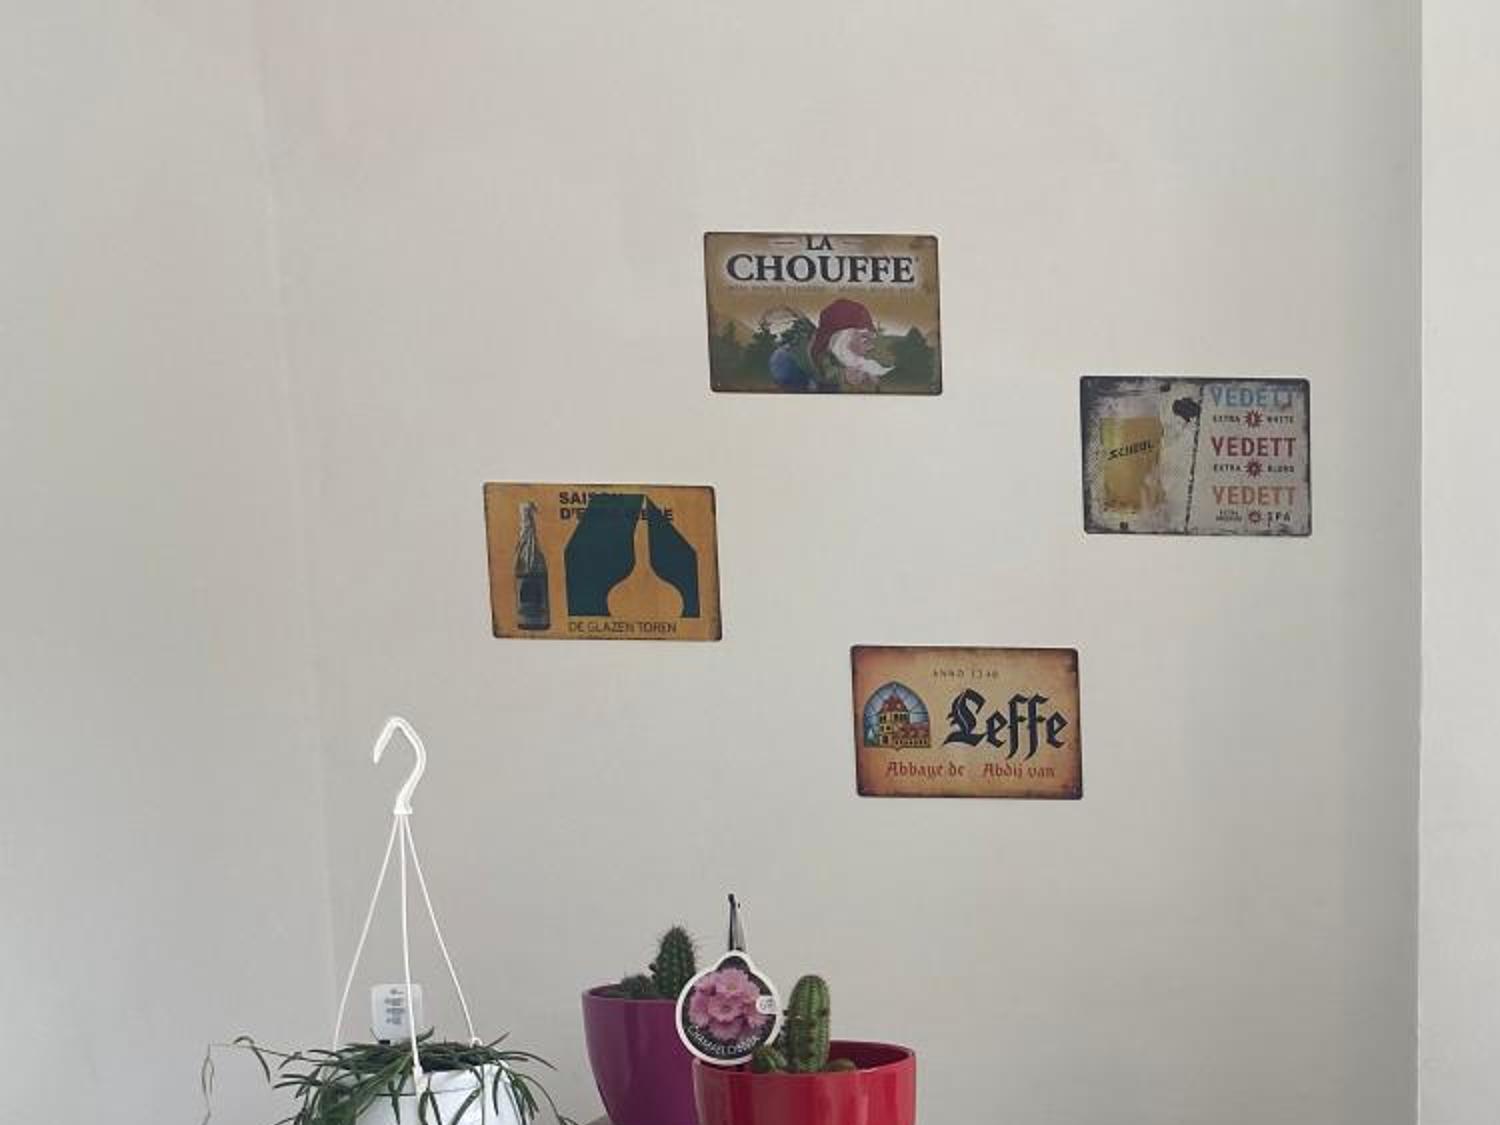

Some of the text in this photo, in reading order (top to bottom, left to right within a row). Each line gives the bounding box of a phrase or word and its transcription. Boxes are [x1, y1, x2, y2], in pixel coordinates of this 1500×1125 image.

[806, 235, 833, 250] LA
[726, 254, 915, 282] CHOUFFE
[1210, 385, 1296, 408] VEDETT
[1211, 436, 1297, 457] VEDETT
[1212, 485, 1297, 506] VEDETT
[569, 621, 585, 633] DE
[943, 687, 1069, 760] Leffe
[885, 760, 944, 780] Abbaye
[949, 760, 966, 777] de
[1027, 765, 1056, 778] van
